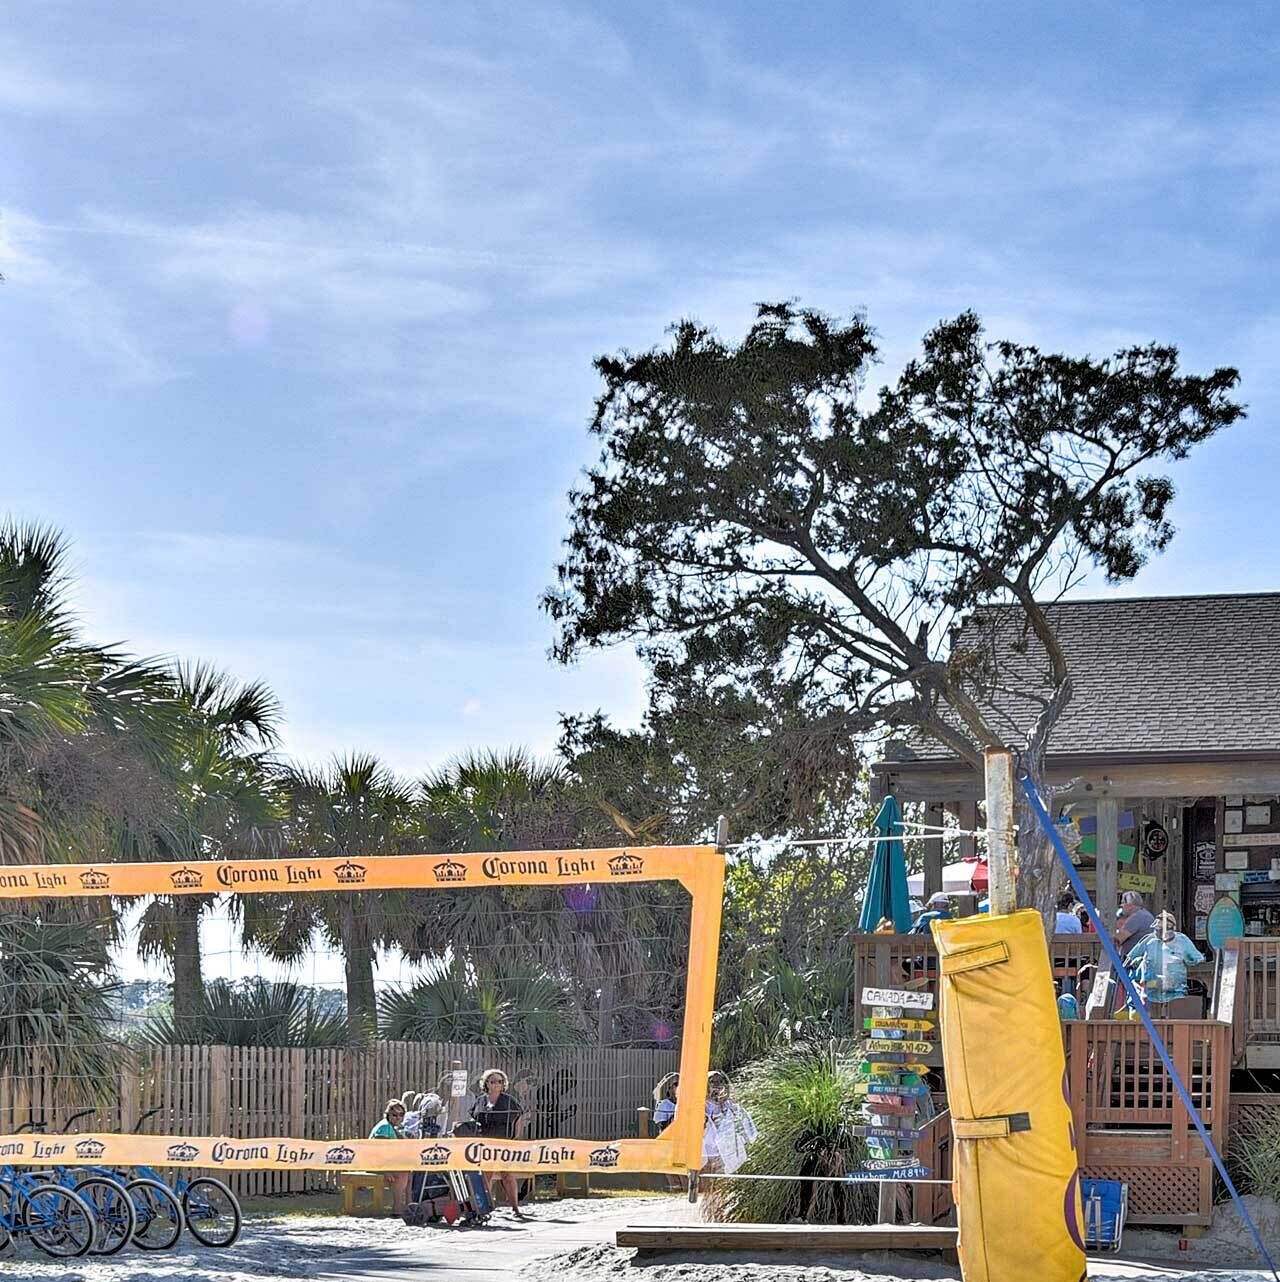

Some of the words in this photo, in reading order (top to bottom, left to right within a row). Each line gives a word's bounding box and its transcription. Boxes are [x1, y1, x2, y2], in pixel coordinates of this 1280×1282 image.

[36, 871, 68, 889] Light
[216, 864, 279, 889] Corona
[286, 865, 322, 884] Light
[482, 857, 549, 880] Corona
[556, 857, 597, 877] Light
[31, 1140, 65, 1159] Light
[211, 1142, 269, 1165] Corona
[276, 1143, 315, 1163] Light
[464, 1142, 532, 1166] Corona
[537, 1143, 576, 1165] Light
